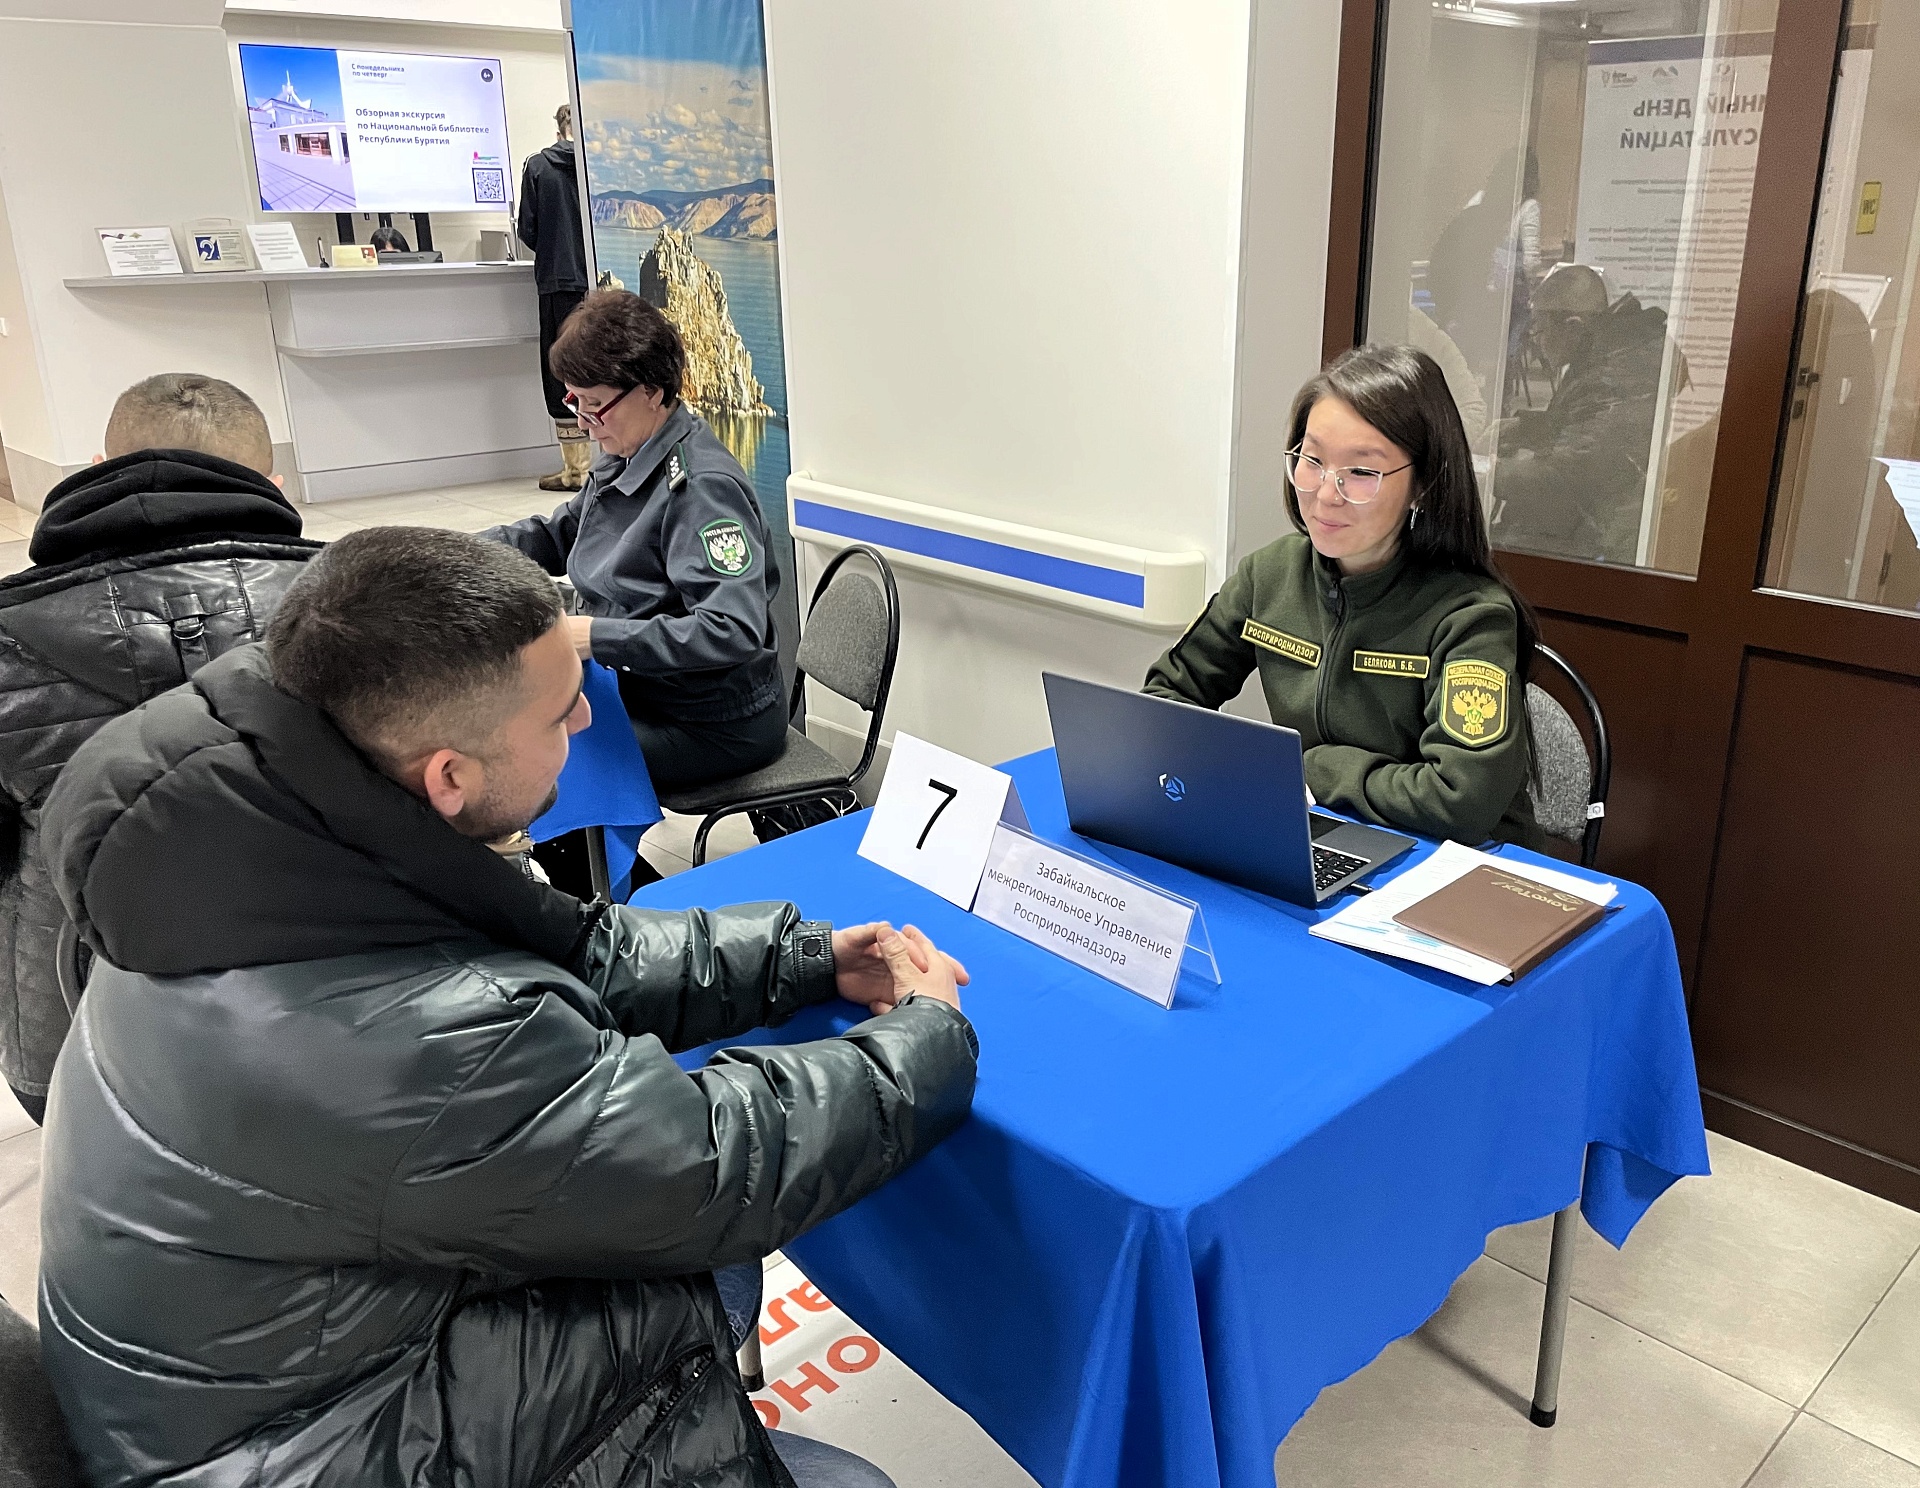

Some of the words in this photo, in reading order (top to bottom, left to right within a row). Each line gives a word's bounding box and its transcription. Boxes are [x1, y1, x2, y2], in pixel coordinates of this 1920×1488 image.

[355, 108, 400, 119] Обзорная
[401, 111, 446, 120] экскурсия
[370, 122, 437, 132] Национальной
[438, 123, 490, 134] библиотеке
[359, 134, 413, 145] Республики
[414, 136, 450, 146] Бурятия
[1247, 625, 1315, 660] РОСПРИРОДНАДЗОР
[1363, 656, 1397, 670] БЕЛЯКОВА
[1400, 660, 1416, 672] Б.Б.
[915, 778, 958, 850] 7
[1036, 861, 1127, 912] Забайкальское
[987, 868, 1092, 924] межрегиональное
[1094, 910, 1172, 960] Управление
[1013, 902, 1127, 967] Росприроднадзора
